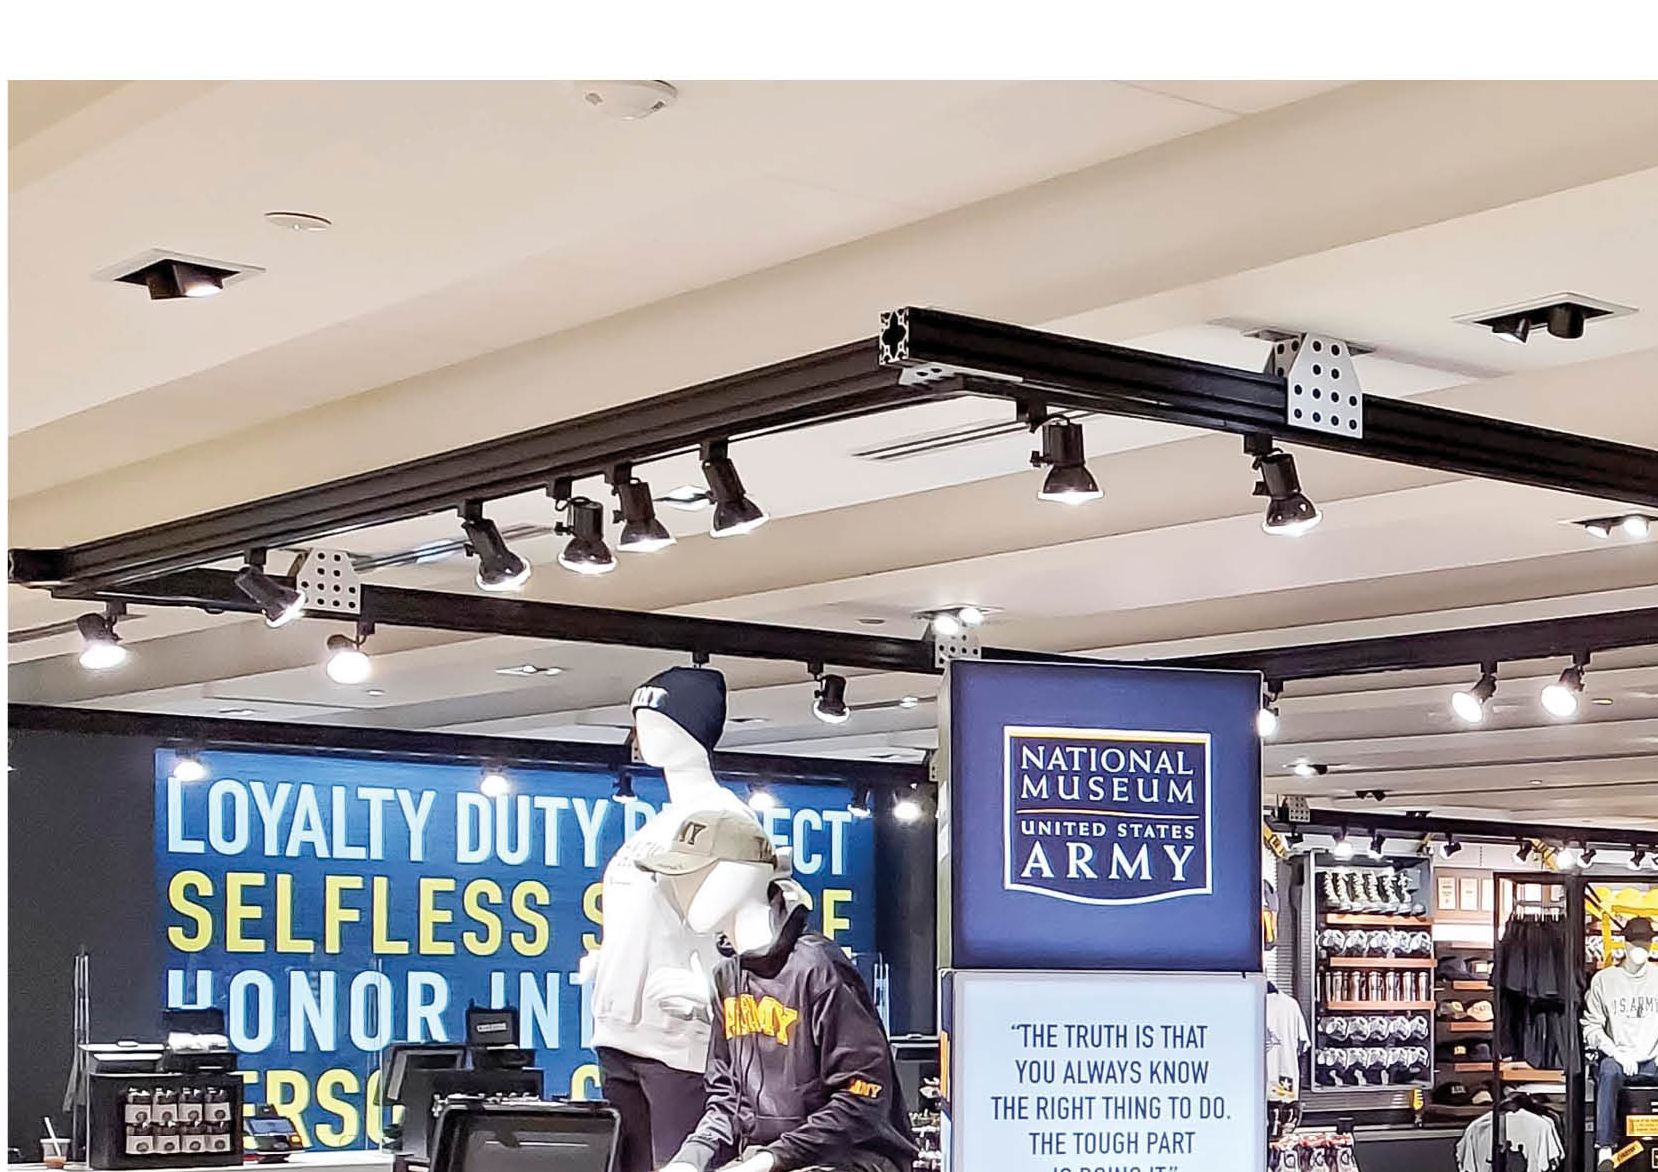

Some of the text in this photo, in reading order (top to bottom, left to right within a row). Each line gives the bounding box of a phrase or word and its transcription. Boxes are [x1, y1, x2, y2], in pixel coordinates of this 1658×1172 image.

[1021, 745, 1194, 775] NATIONAL
[1021, 774, 1194, 803] MUSEUM
[167, 777, 437, 863] LOYALTY
[456, 791, 610, 868] DUTY
[1021, 820, 1195, 839] UNITED STATES
[1020, 840, 1195, 881] ARMY
[167, 870, 551, 957] SELFLESS
[1011, 1024, 1208, 1049] “THE TRUTH IS THAT
[1015, 1060, 1209, 1084] YOU ALWAYS KNOW
[990, 1096, 1231, 1120] THE RIGHT THING TO DO.
[1029, 1131, 1195, 1155] THE TOUGH PART
